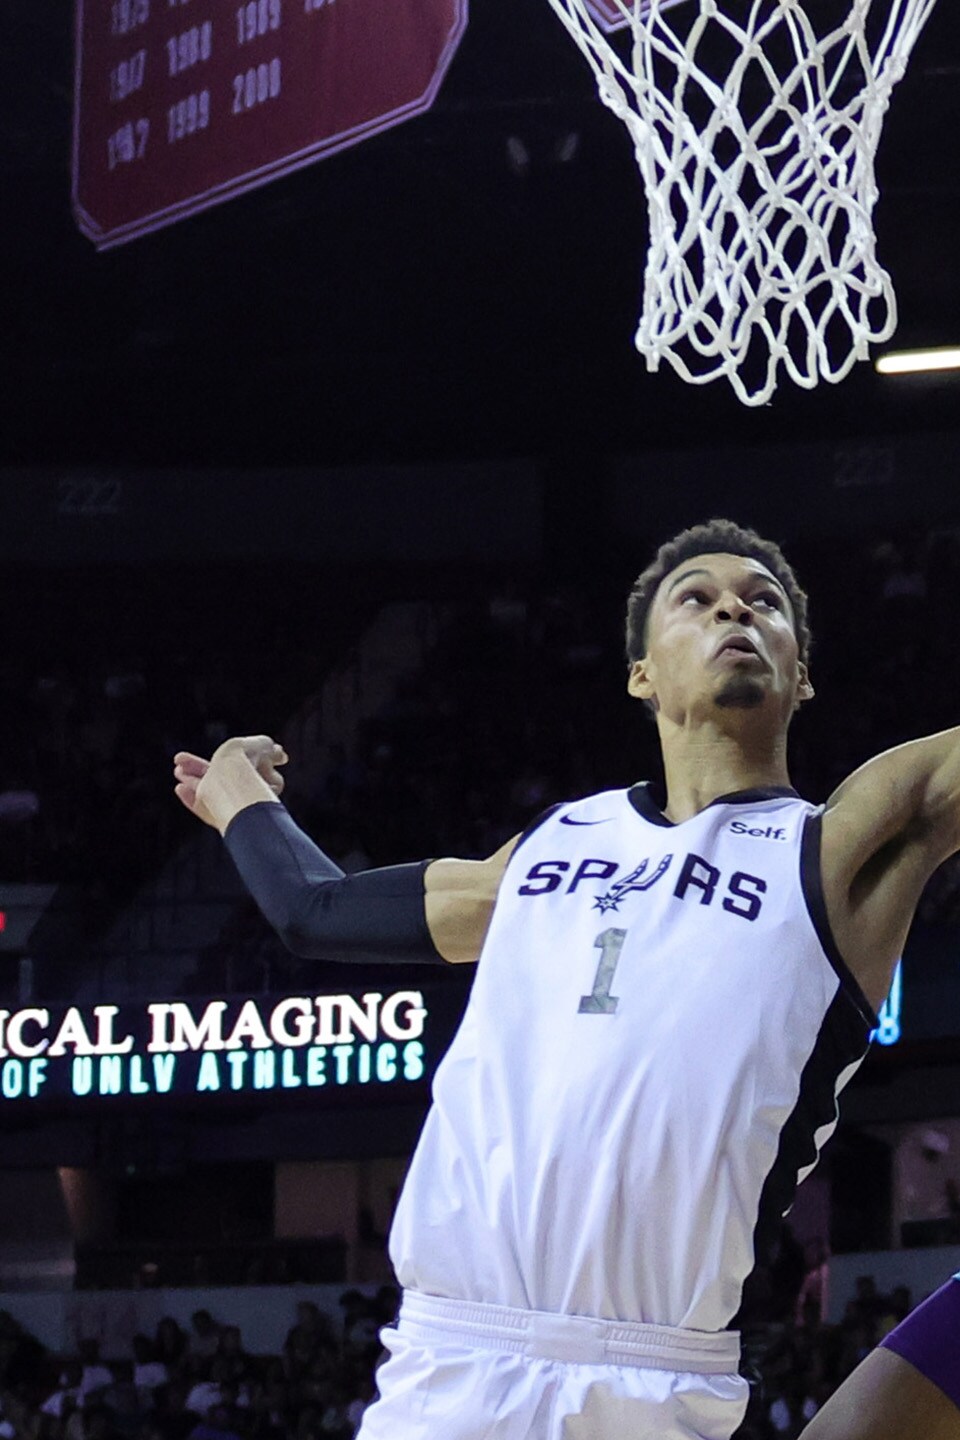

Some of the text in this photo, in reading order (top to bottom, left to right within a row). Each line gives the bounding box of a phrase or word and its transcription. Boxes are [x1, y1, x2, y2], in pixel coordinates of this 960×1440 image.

[233, 57, 281, 114] 2000
[57, 476, 123, 516] 222
[729, 821, 787, 841] Self.
[517, 853, 768, 922] SPURS
[577, 927, 628, 1015] 1
[147, 990, 428, 1053] IMAGING
[1, 1040, 425, 1098] OF UNLV ATHLETICS
